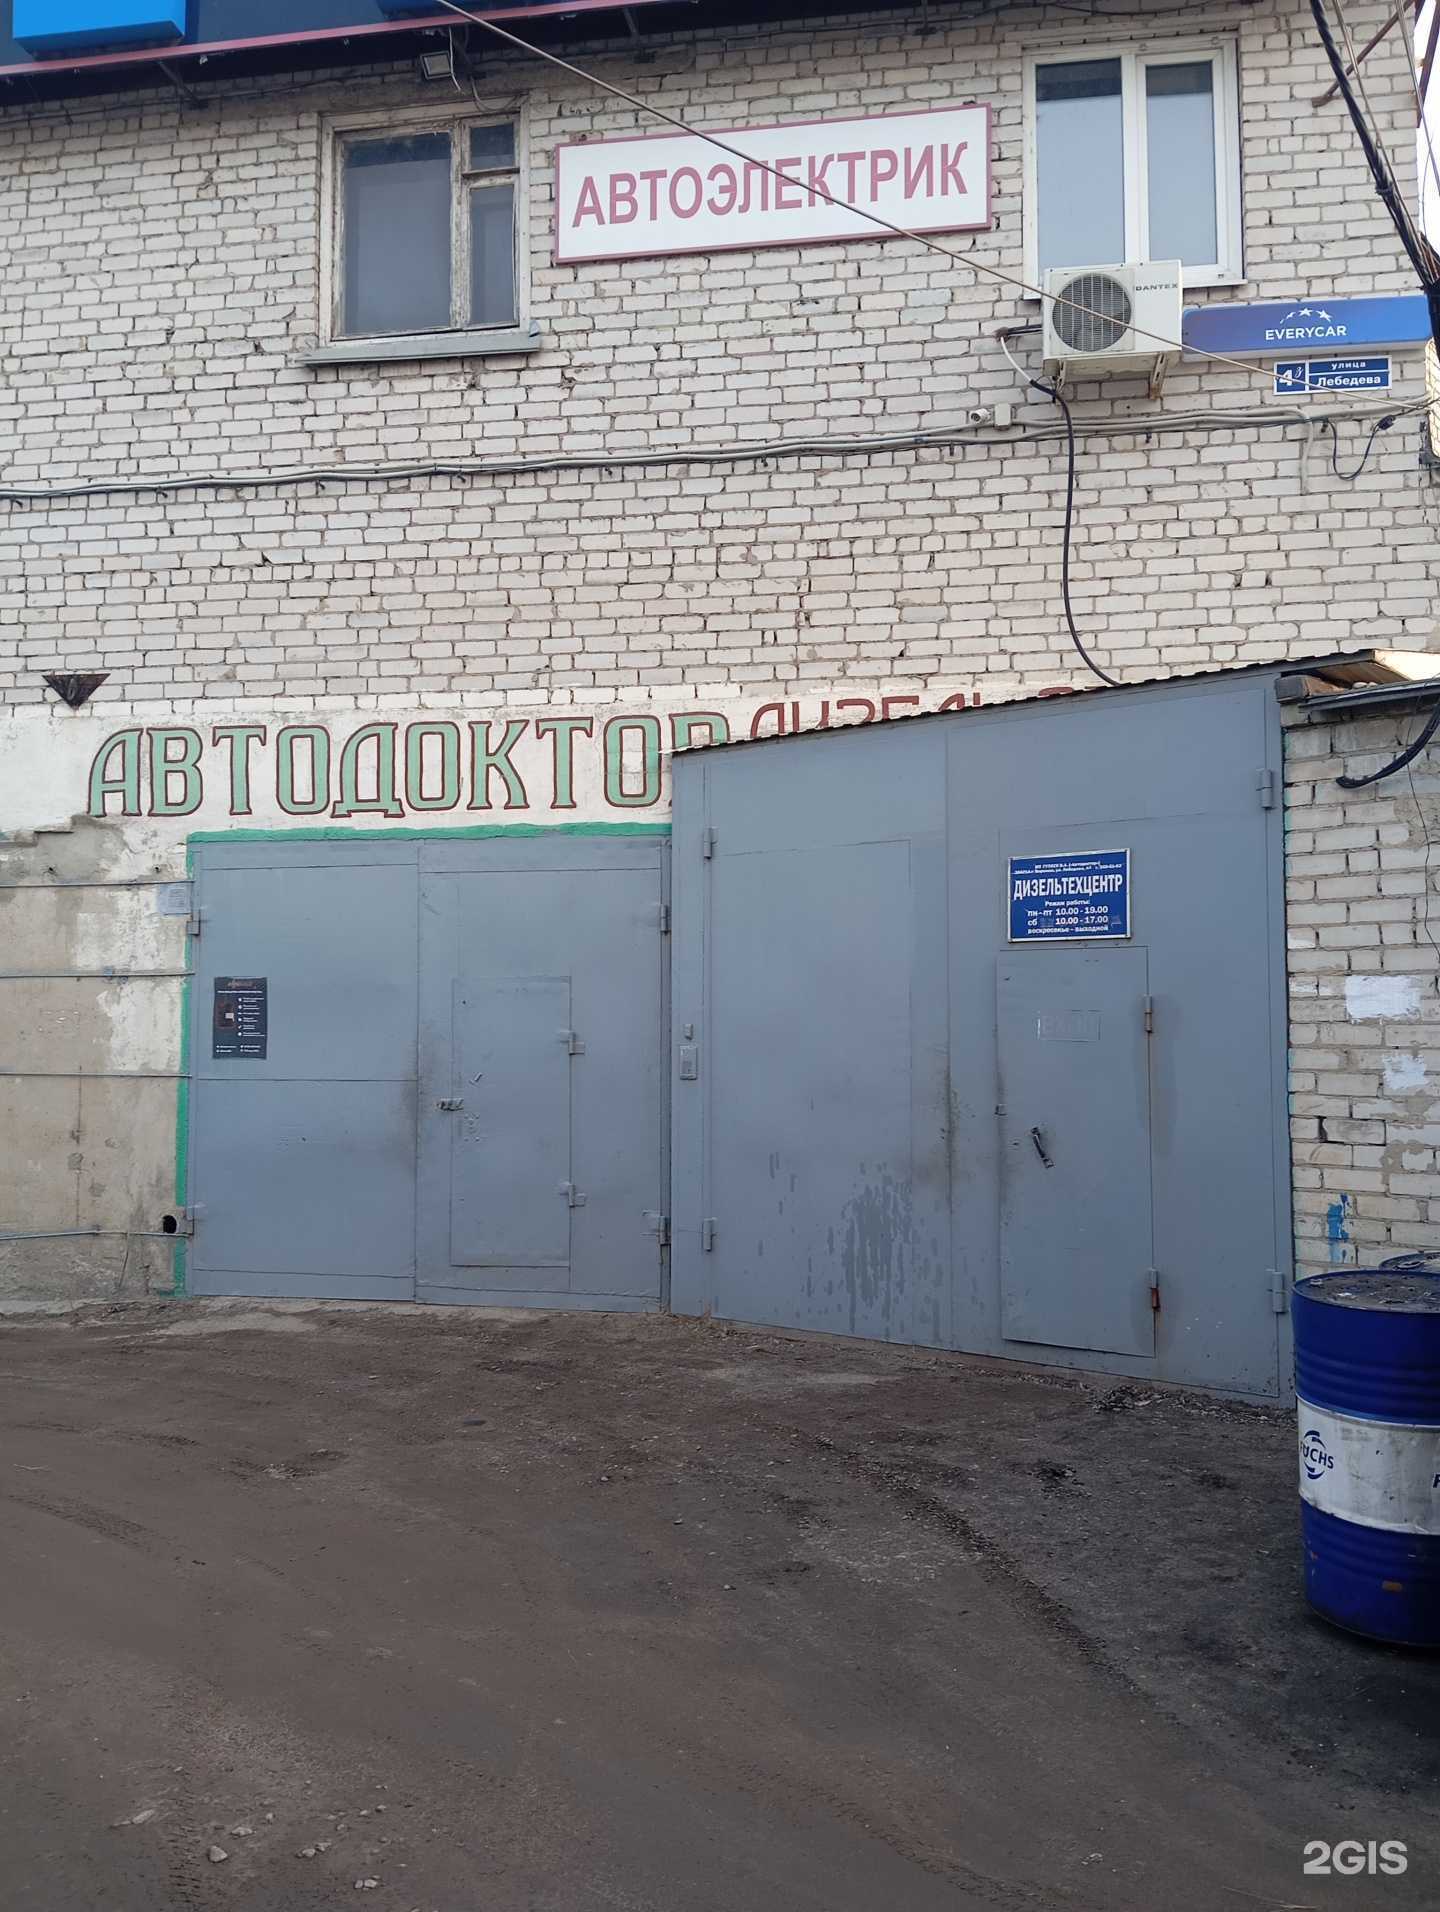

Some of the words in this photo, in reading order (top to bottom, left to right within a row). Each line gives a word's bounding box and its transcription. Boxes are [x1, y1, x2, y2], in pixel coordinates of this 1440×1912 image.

[572, 141, 969, 228] АВТОЭЛЕКТРИК
[1136, 283, 1178, 291] DANTEX
[1265, 325, 1347, 341] EVERYCAR
[1331, 361, 1367, 371] улица
[1317, 375, 1382, 388] Лебедева
[1013, 874, 1123, 900] ДИЗЕЛЬТЕХЦЕНТР
[1055, 908, 1079, 916] 10.00
[1084, 906, 1109, 914] 19.00
[1027, 918, 1038, 926] сб
[1055, 917, 1079, 925] 10.00
[1084, 916, 1109, 924] 17.00
